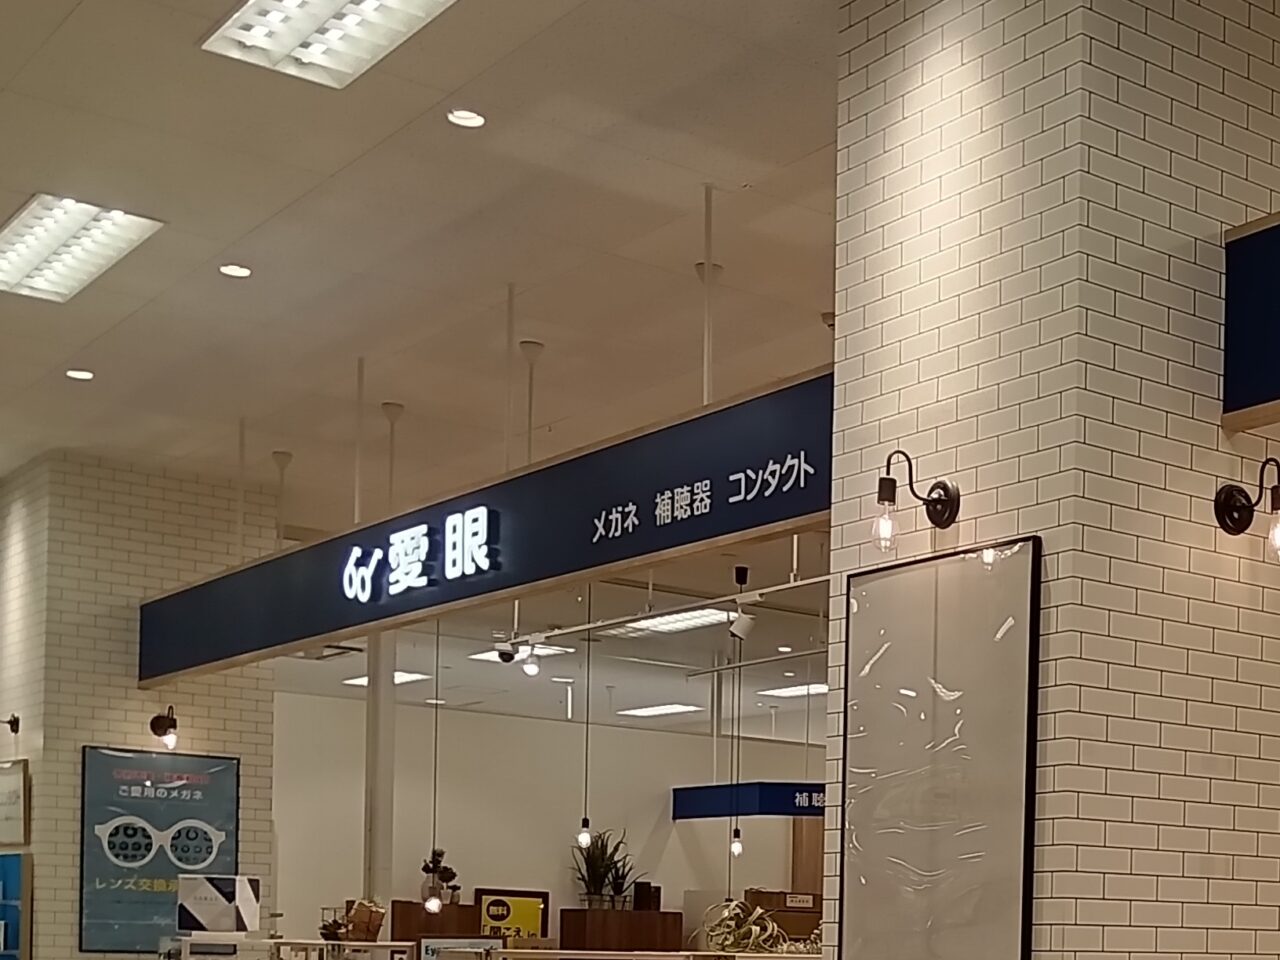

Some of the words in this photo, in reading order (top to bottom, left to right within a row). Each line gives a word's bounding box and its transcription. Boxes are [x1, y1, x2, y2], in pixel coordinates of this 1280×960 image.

[591, 502, 640, 543] メガネ
[655, 480, 711, 526] 補聴器
[729, 450, 814, 503] コンタクト
